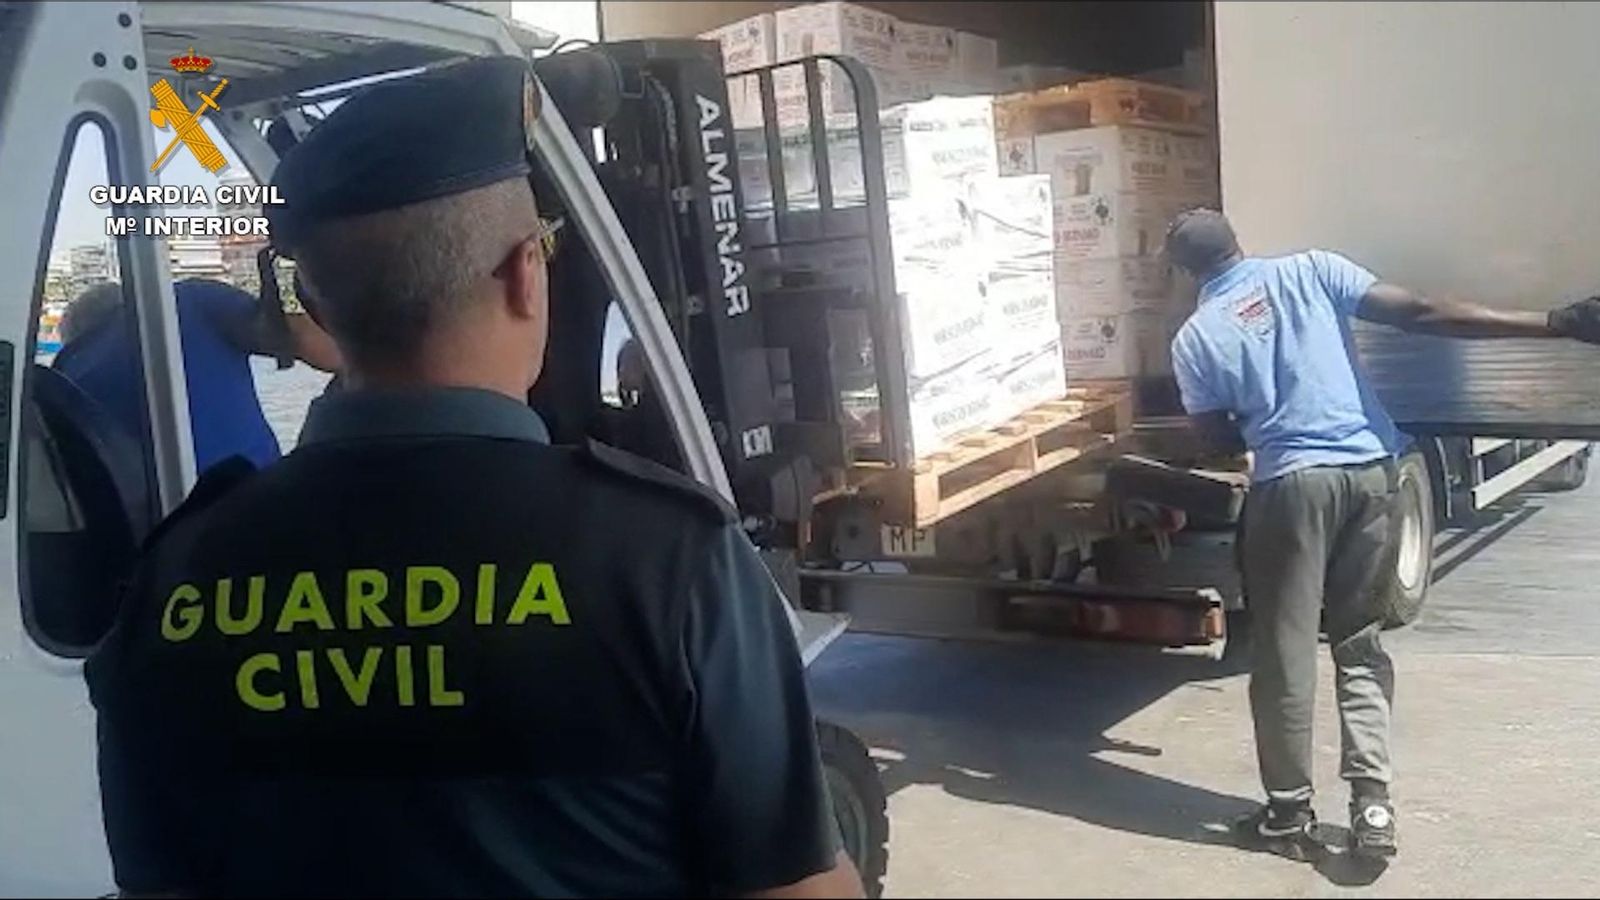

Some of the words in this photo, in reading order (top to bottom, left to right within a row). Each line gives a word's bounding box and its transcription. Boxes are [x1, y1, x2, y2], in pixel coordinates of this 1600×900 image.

[696, 95, 751, 317] ALMENAR
[160, 563, 572, 642] GUARDIA
[235, 645, 465, 711] CIVIL
